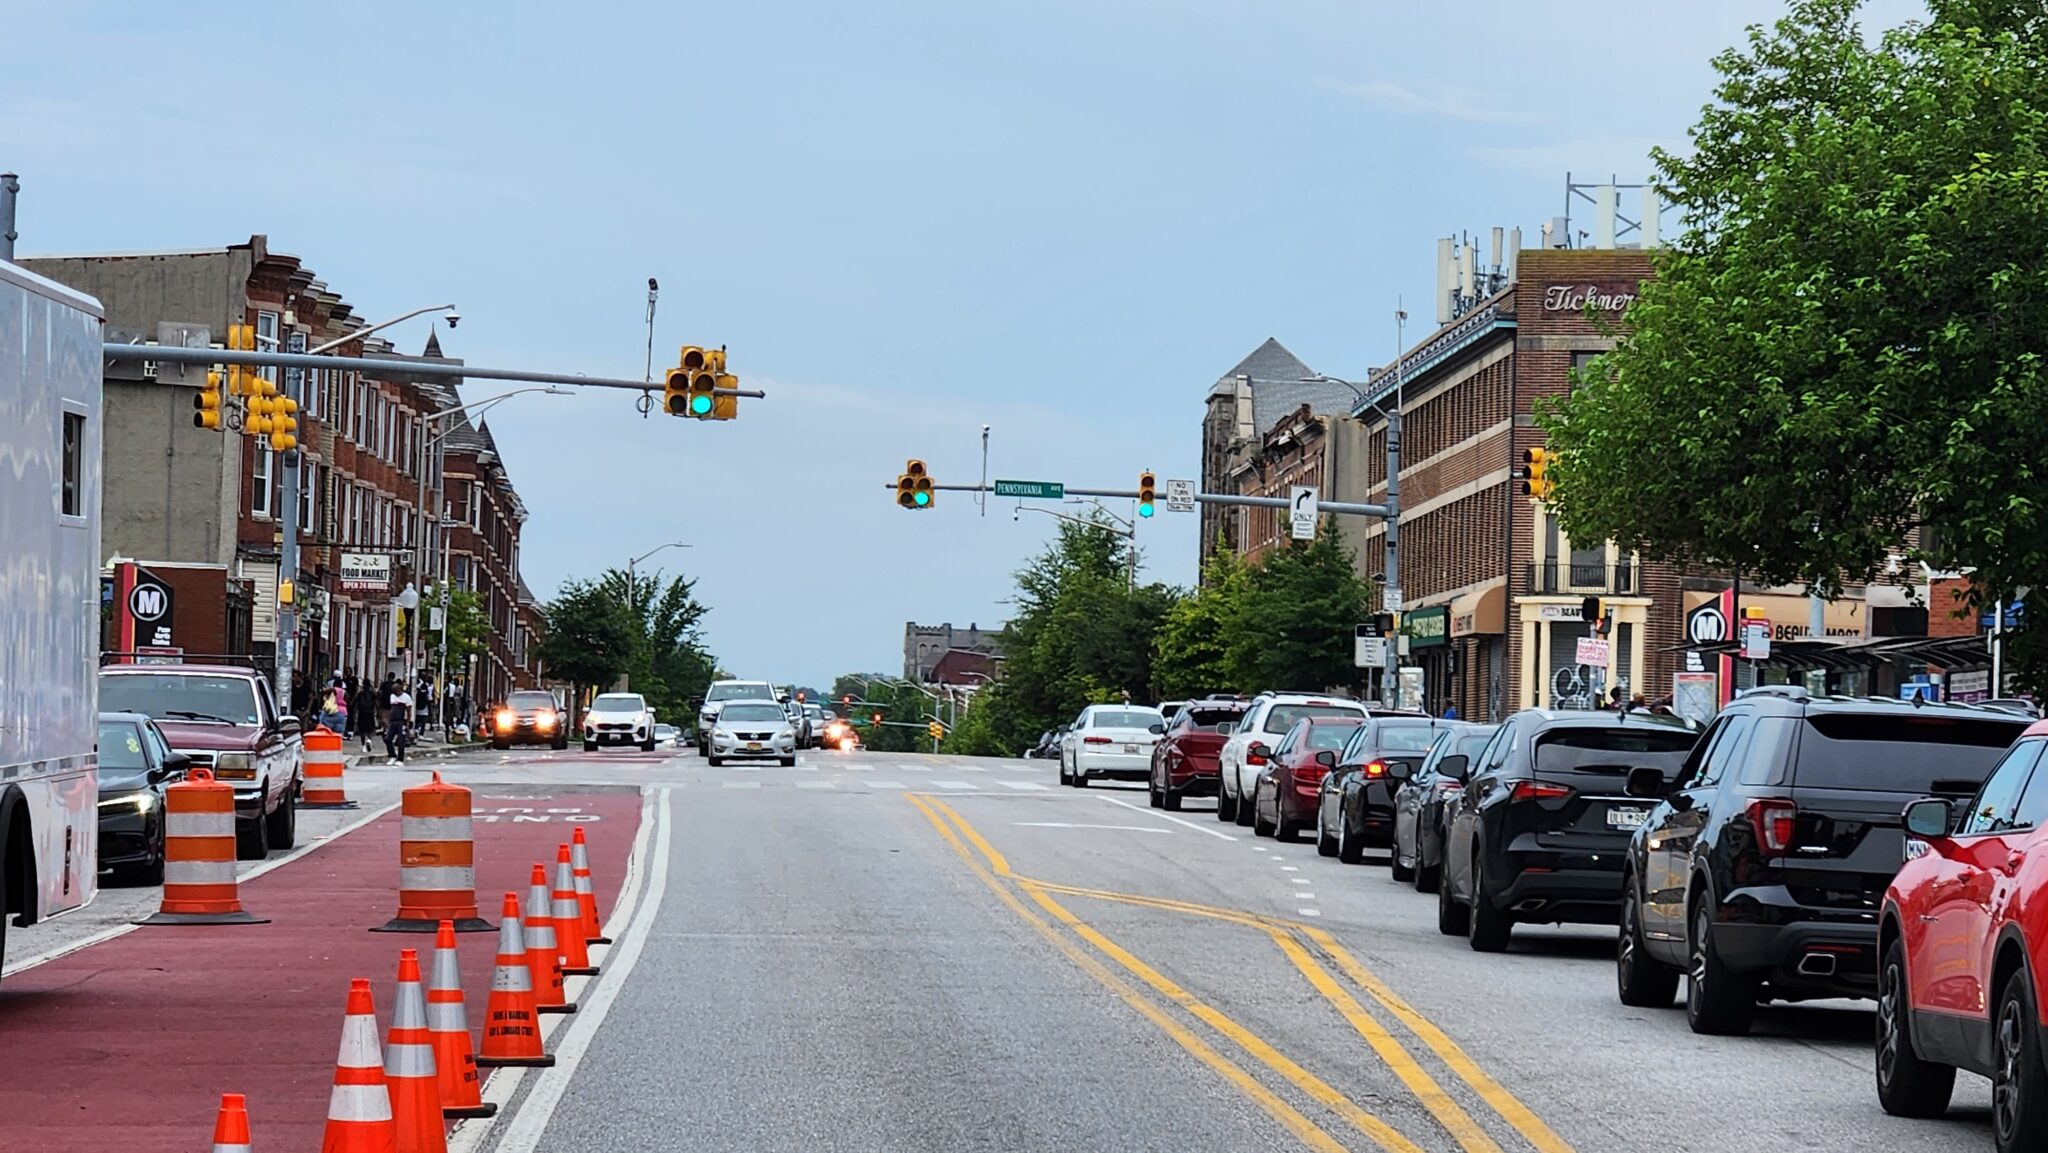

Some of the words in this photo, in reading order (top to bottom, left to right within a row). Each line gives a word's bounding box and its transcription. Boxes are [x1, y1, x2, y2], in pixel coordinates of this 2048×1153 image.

[1544, 286, 1637, 311] Tickner
[997, 483, 1043, 495] PENNSYLVANIA
[1294, 513, 1312, 521] ONLY
[342, 568, 360, 577] FOOD
[361, 569, 388, 579] MARKET
[368, 582, 388, 590] HOURS
[138, 590, 160, 614] M
[1561, 607, 1582, 617] BEAU
[1697, 616, 1717, 639] M
